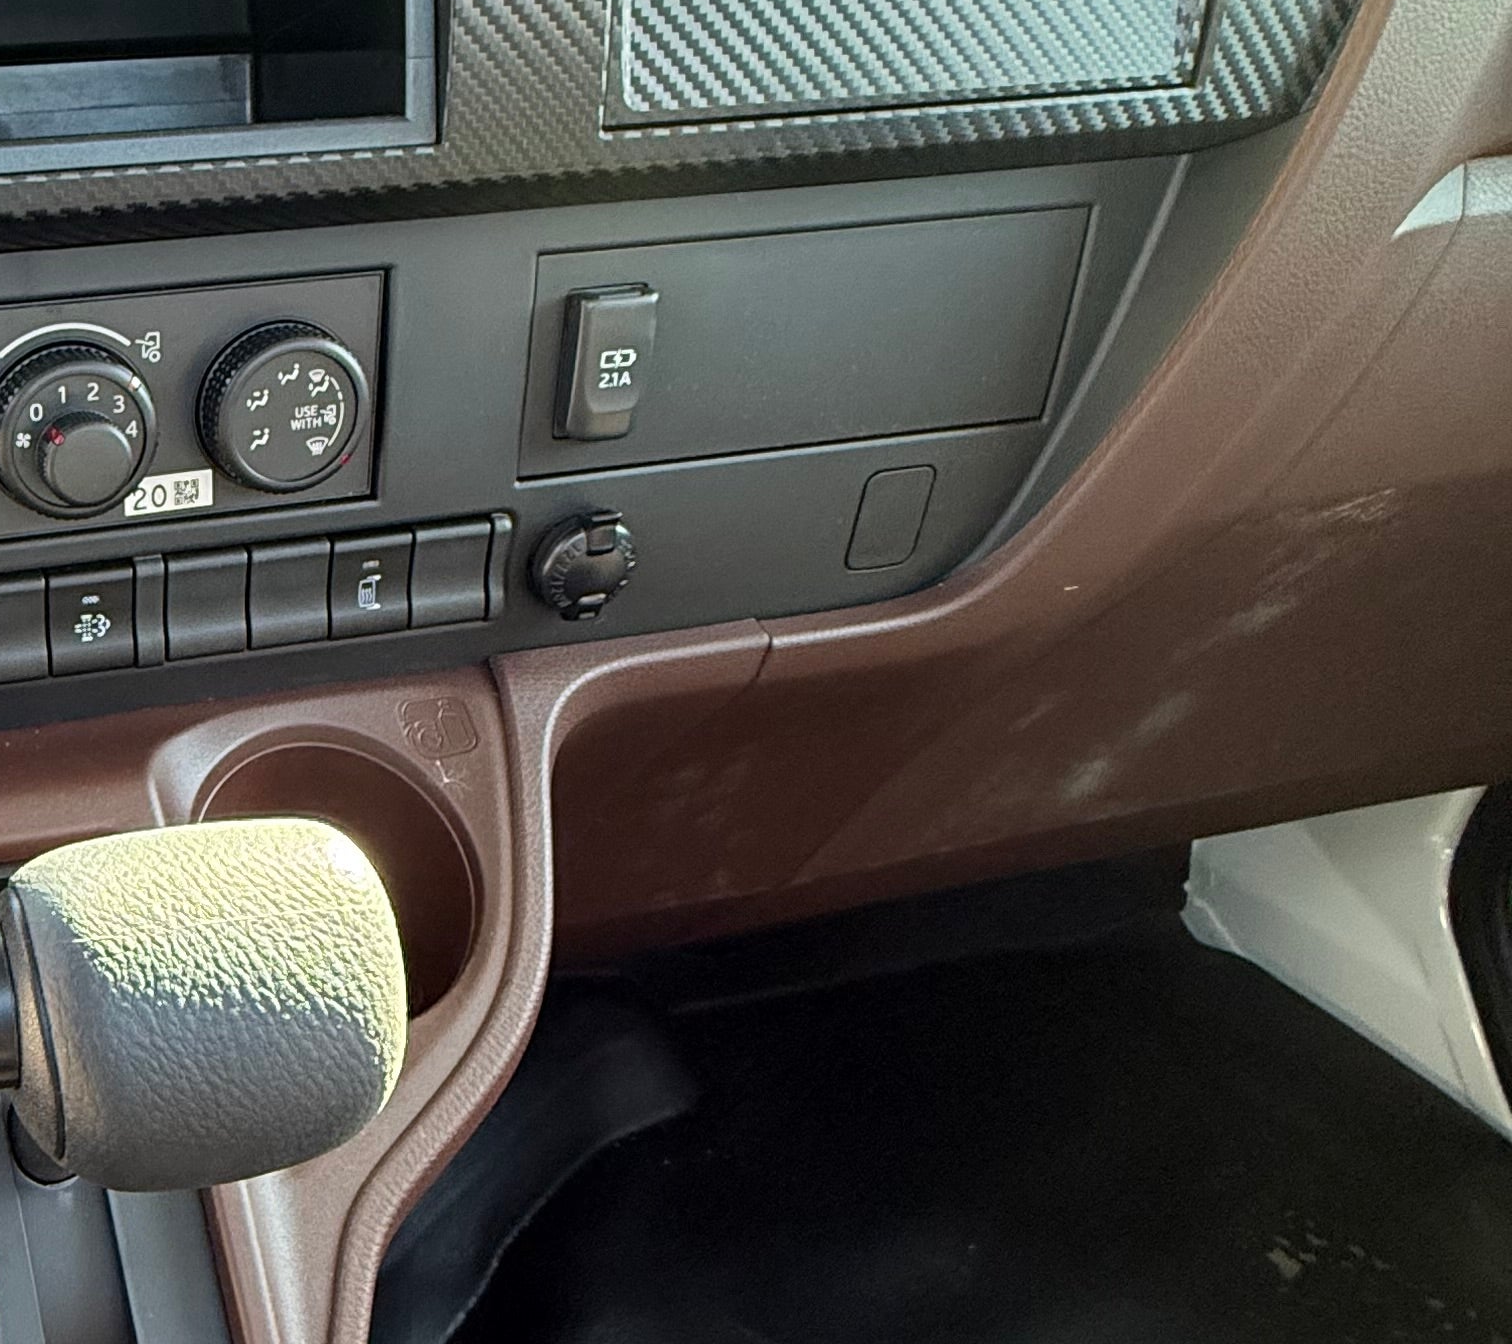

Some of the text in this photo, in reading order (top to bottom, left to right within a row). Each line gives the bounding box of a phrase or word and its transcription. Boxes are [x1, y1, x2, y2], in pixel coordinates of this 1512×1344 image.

[598, 371, 632, 389] 2.1A
[29, 383, 138, 438] 0 1 2 3 4
[295, 405, 318, 418] USE
[290, 416, 322, 431] WITH
[132, 484, 167, 511] 20
